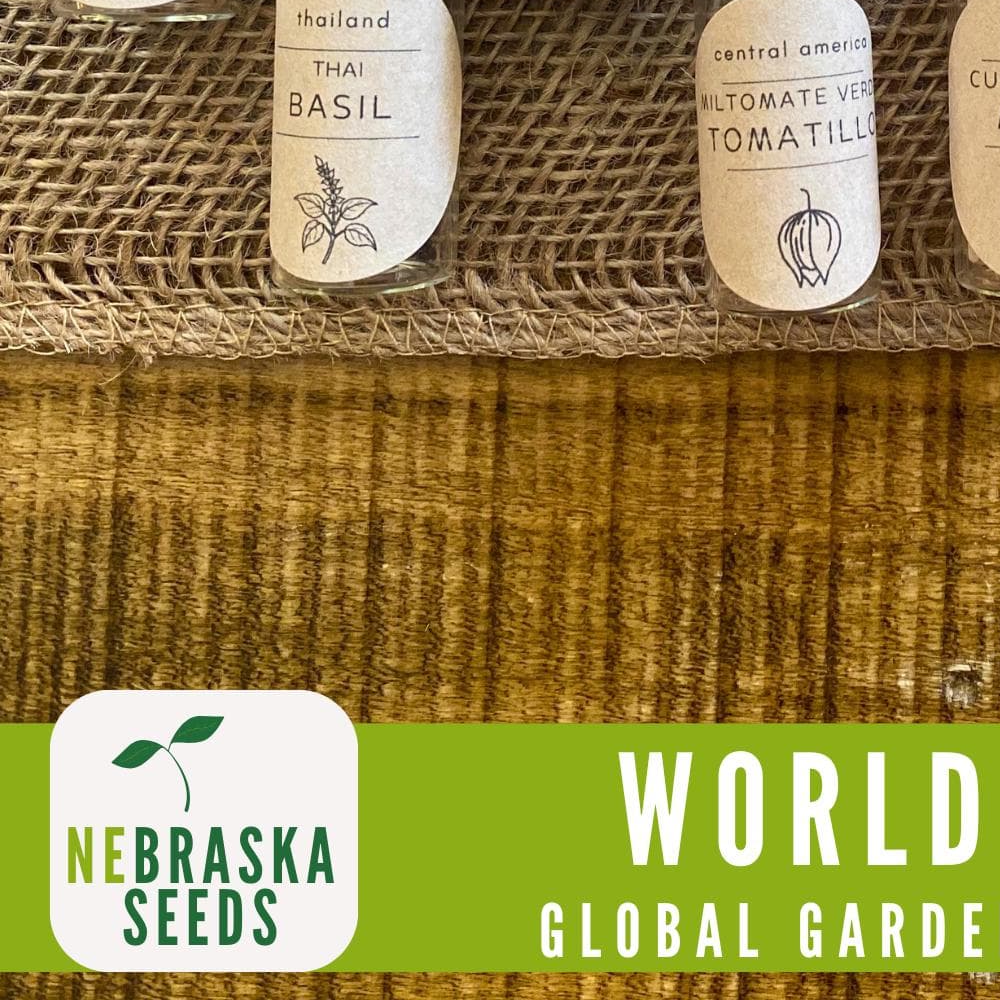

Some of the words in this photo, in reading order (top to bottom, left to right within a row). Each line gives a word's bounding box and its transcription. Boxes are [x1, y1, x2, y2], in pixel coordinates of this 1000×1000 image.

[297, 8, 389, 28] thailand
[714, 40, 787, 62] central
[800, 37, 867, 55] america
[313, 60, 362, 77] THAI
[289, 92, 391, 119] BASIL
[701, 87, 827, 111] MILTOMATE
[708, 112, 877, 152] TOMATILLO
